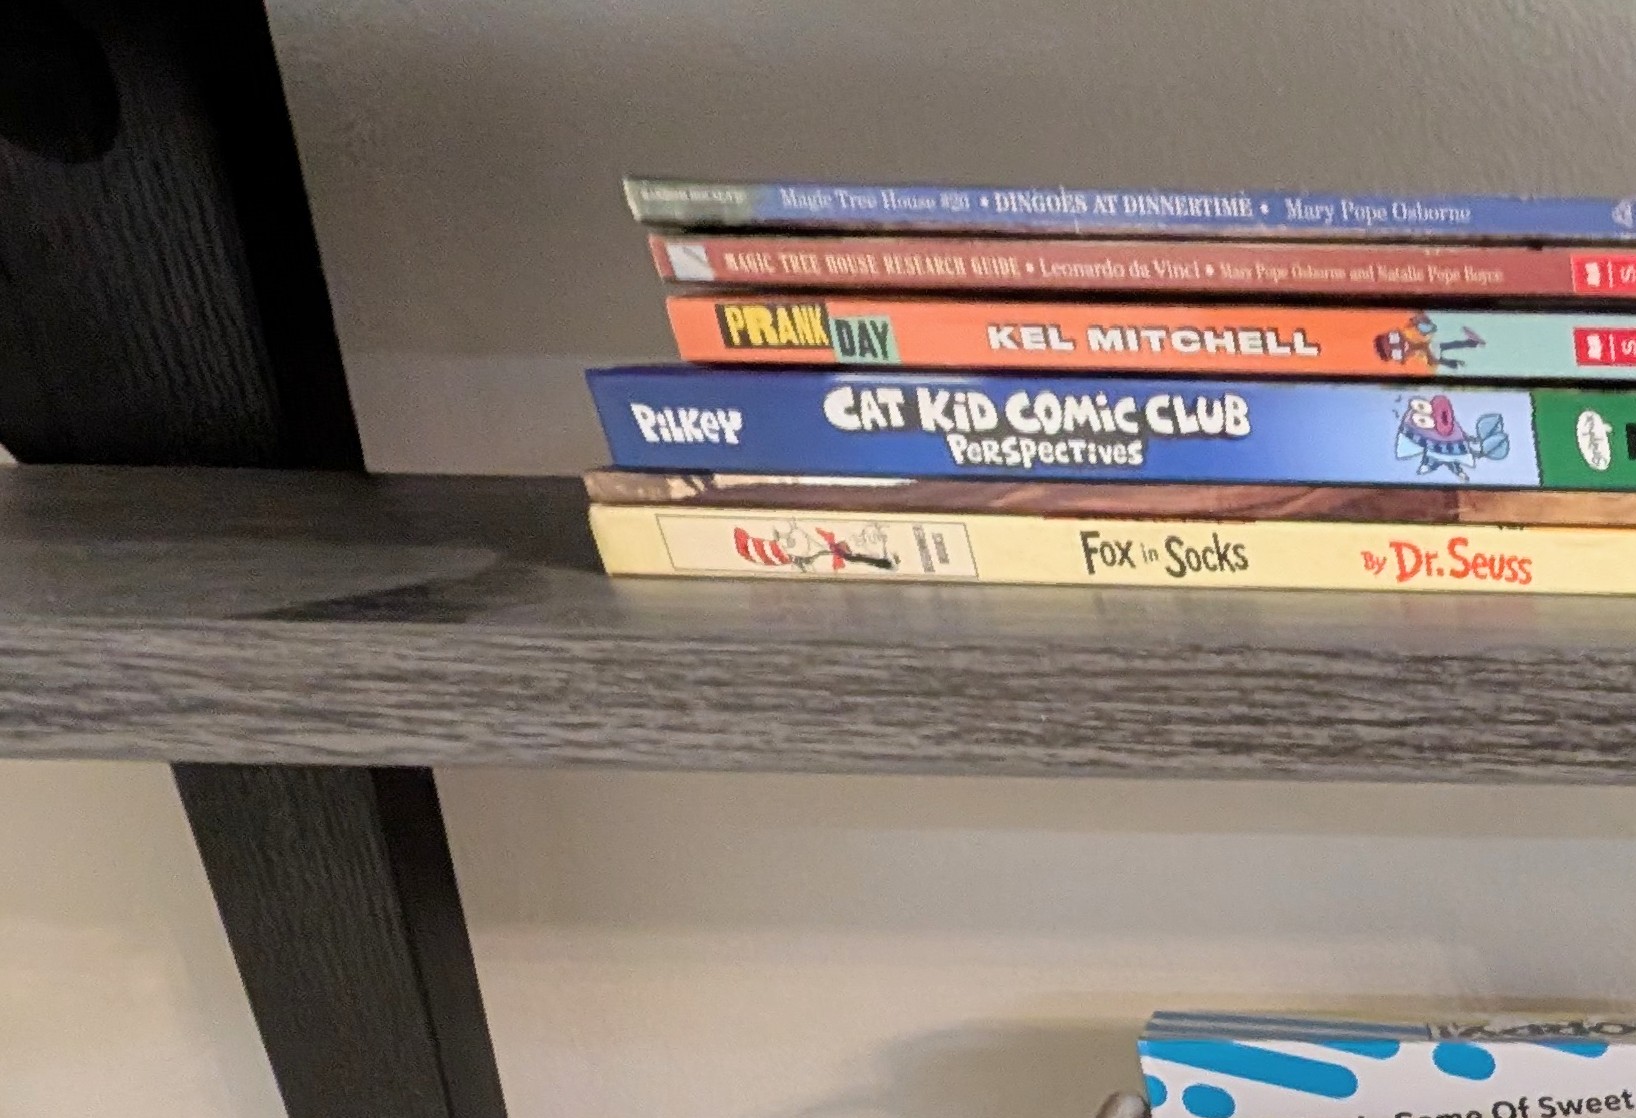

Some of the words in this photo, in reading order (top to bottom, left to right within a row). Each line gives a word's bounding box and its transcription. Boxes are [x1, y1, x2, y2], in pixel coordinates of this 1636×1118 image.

[780, 187, 831, 212] Magic
[834, 188, 877, 211] Tree
[881, 189, 936, 211] House
[994, 190, 1088, 214] DINGOES
[1093, 193, 1118, 215] AT
[1122, 193, 1253, 218] DINNERTIME
[1284, 197, 1334, 225] Mary
[1340, 199, 1388, 225] Pope
[1392, 200, 1471, 223] Osborne
[723, 252, 776, 274] MAGIC
[778, 253, 820, 275] TREE
[825, 253, 878, 276] HOUSE
[883, 254, 967, 277] RESEARCH
[971, 256, 1021, 278] GUIDE
[1039, 257, 1126, 279] Leonardo
[1129, 260, 1151, 279] da
[1153, 260, 1200, 279] Vinci
[1255, 262, 1288, 283] Pope
[1291, 263, 1347, 281] Osborne
[1349, 264, 1375, 281] and
[1427, 265, 1461, 284] Pope
[724, 305, 830, 346] PRANK
[835, 318, 889, 361] DAY
[985, 324, 1077, 352] KEL
[1086, 325, 1322, 358] MITCHELL
[823, 386, 906, 432] CAT
[1146, 391, 1252, 437] CLUB
[1079, 530, 1136, 576] Fox
[1140, 541, 1159, 564] in
[1163, 531, 1249, 578] Socks
[1361, 549, 1387, 575] By
[1388, 539, 1443, 583] Dr.
[1447, 536, 1533, 586] Seuss
